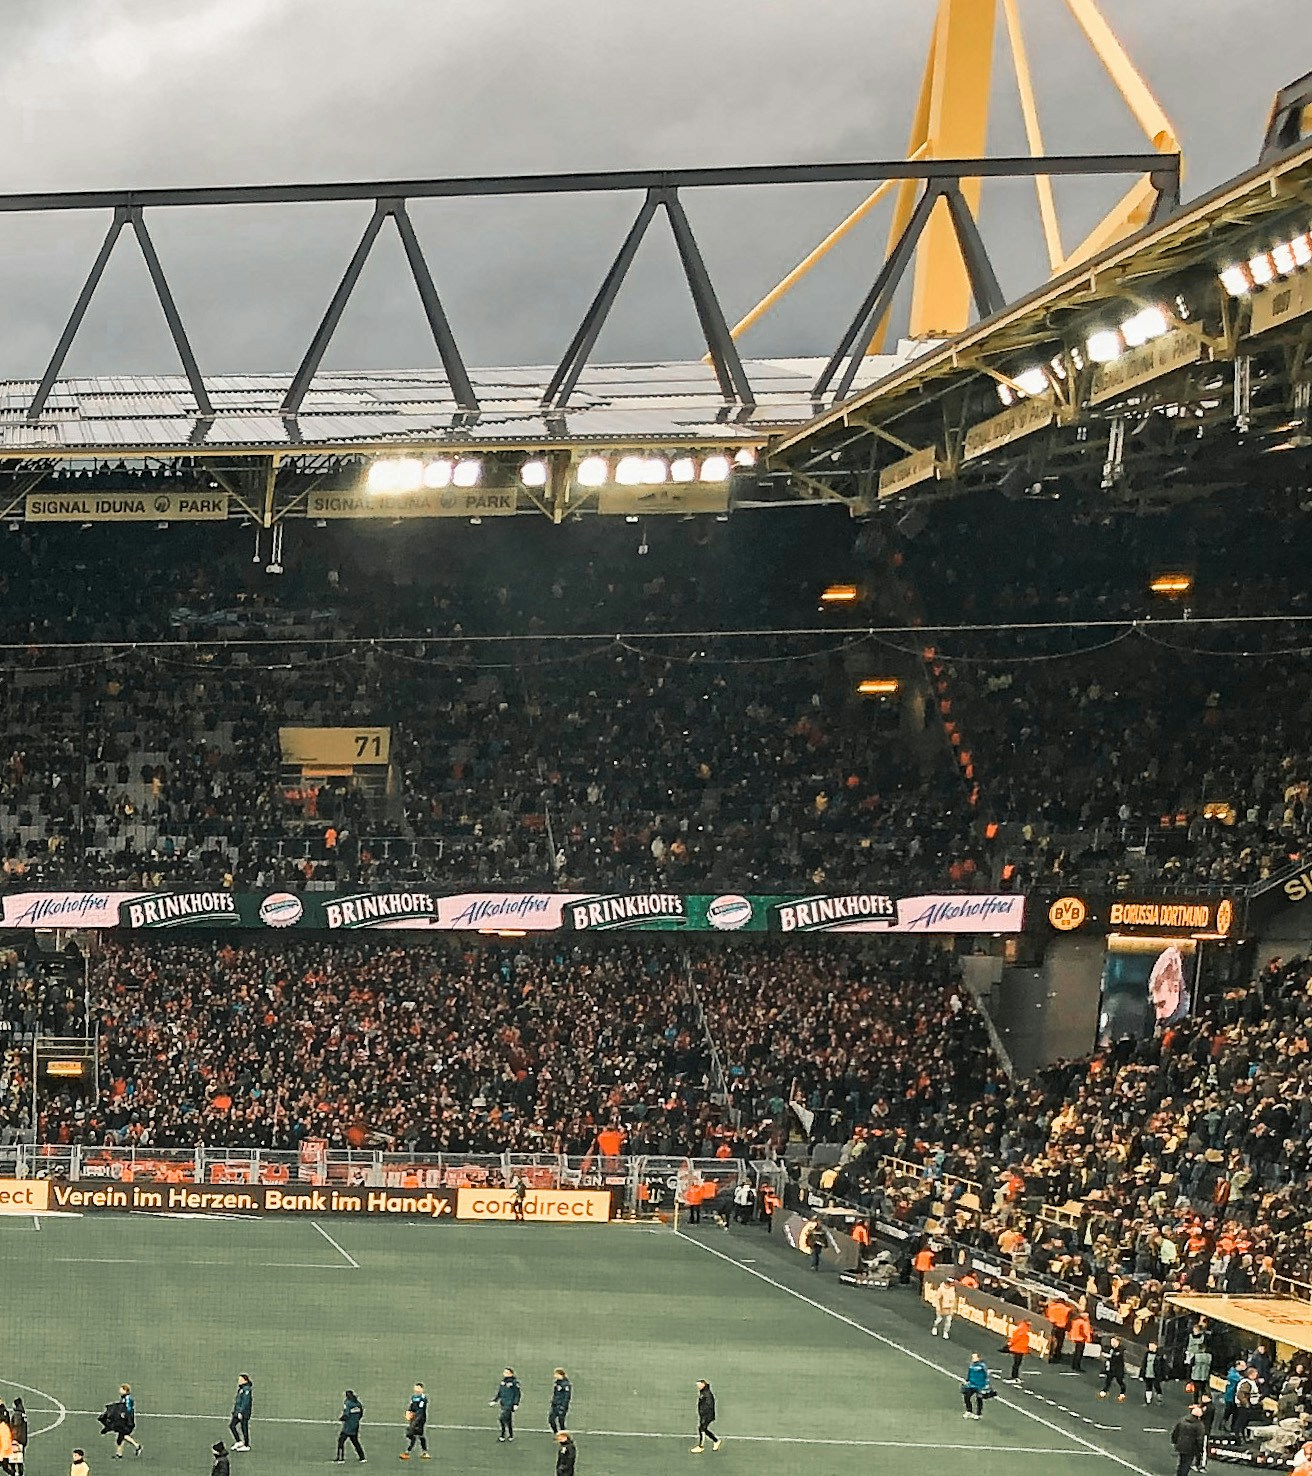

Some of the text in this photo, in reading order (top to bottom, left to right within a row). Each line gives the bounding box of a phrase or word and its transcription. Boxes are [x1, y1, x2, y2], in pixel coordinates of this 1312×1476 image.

[31, 499, 223, 515] SIGNAL IDUNA PARK
[465, 495, 510, 509] PARK
[355, 735, 382, 757] 71
[1055, 903, 1080, 920] BVB
[54, 1185, 452, 1217] Verein im Herzen. Bank im Handy.
